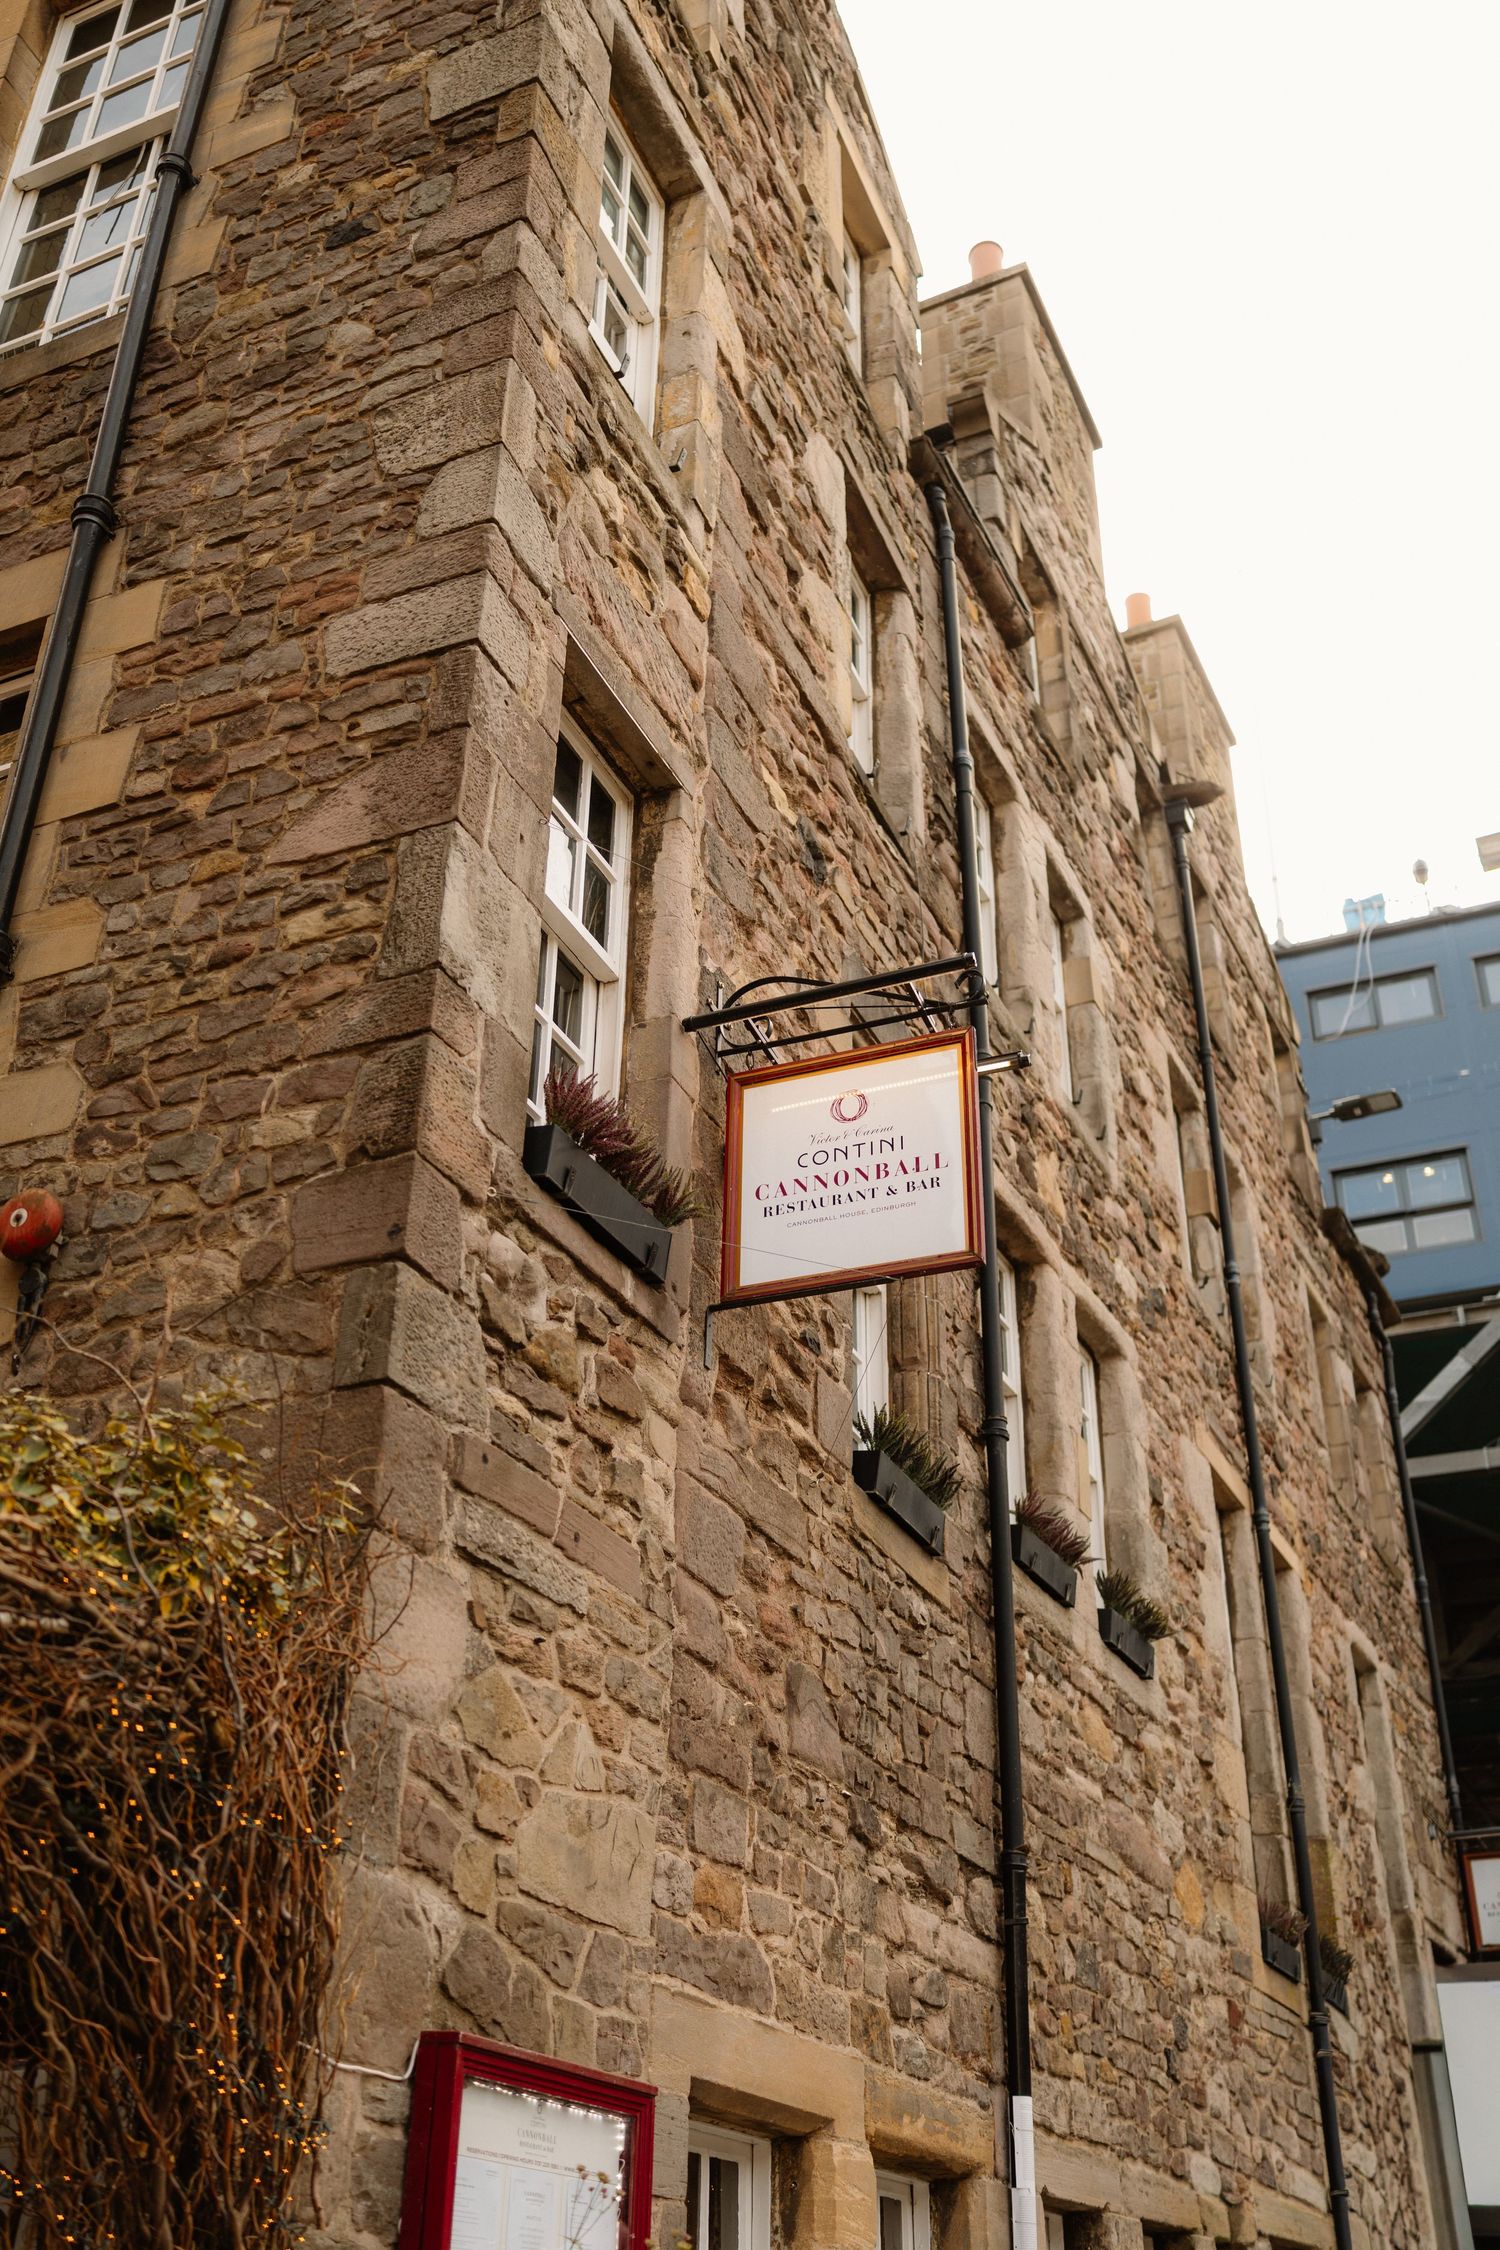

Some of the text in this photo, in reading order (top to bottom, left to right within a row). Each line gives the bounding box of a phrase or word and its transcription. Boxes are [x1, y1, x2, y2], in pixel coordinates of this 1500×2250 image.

[797, 1135, 904, 1168] CONTINI
[809, 1132, 841, 1146] Victor
[853, 1125, 894, 1137] Carina
[755, 1152, 949, 1201] CANNONBALL
[763, 1176, 941, 1218] RESTAURANT & BAR
[786, 1201, 916, 1228] CANNONBALL HOUSE, EDINBURGH
